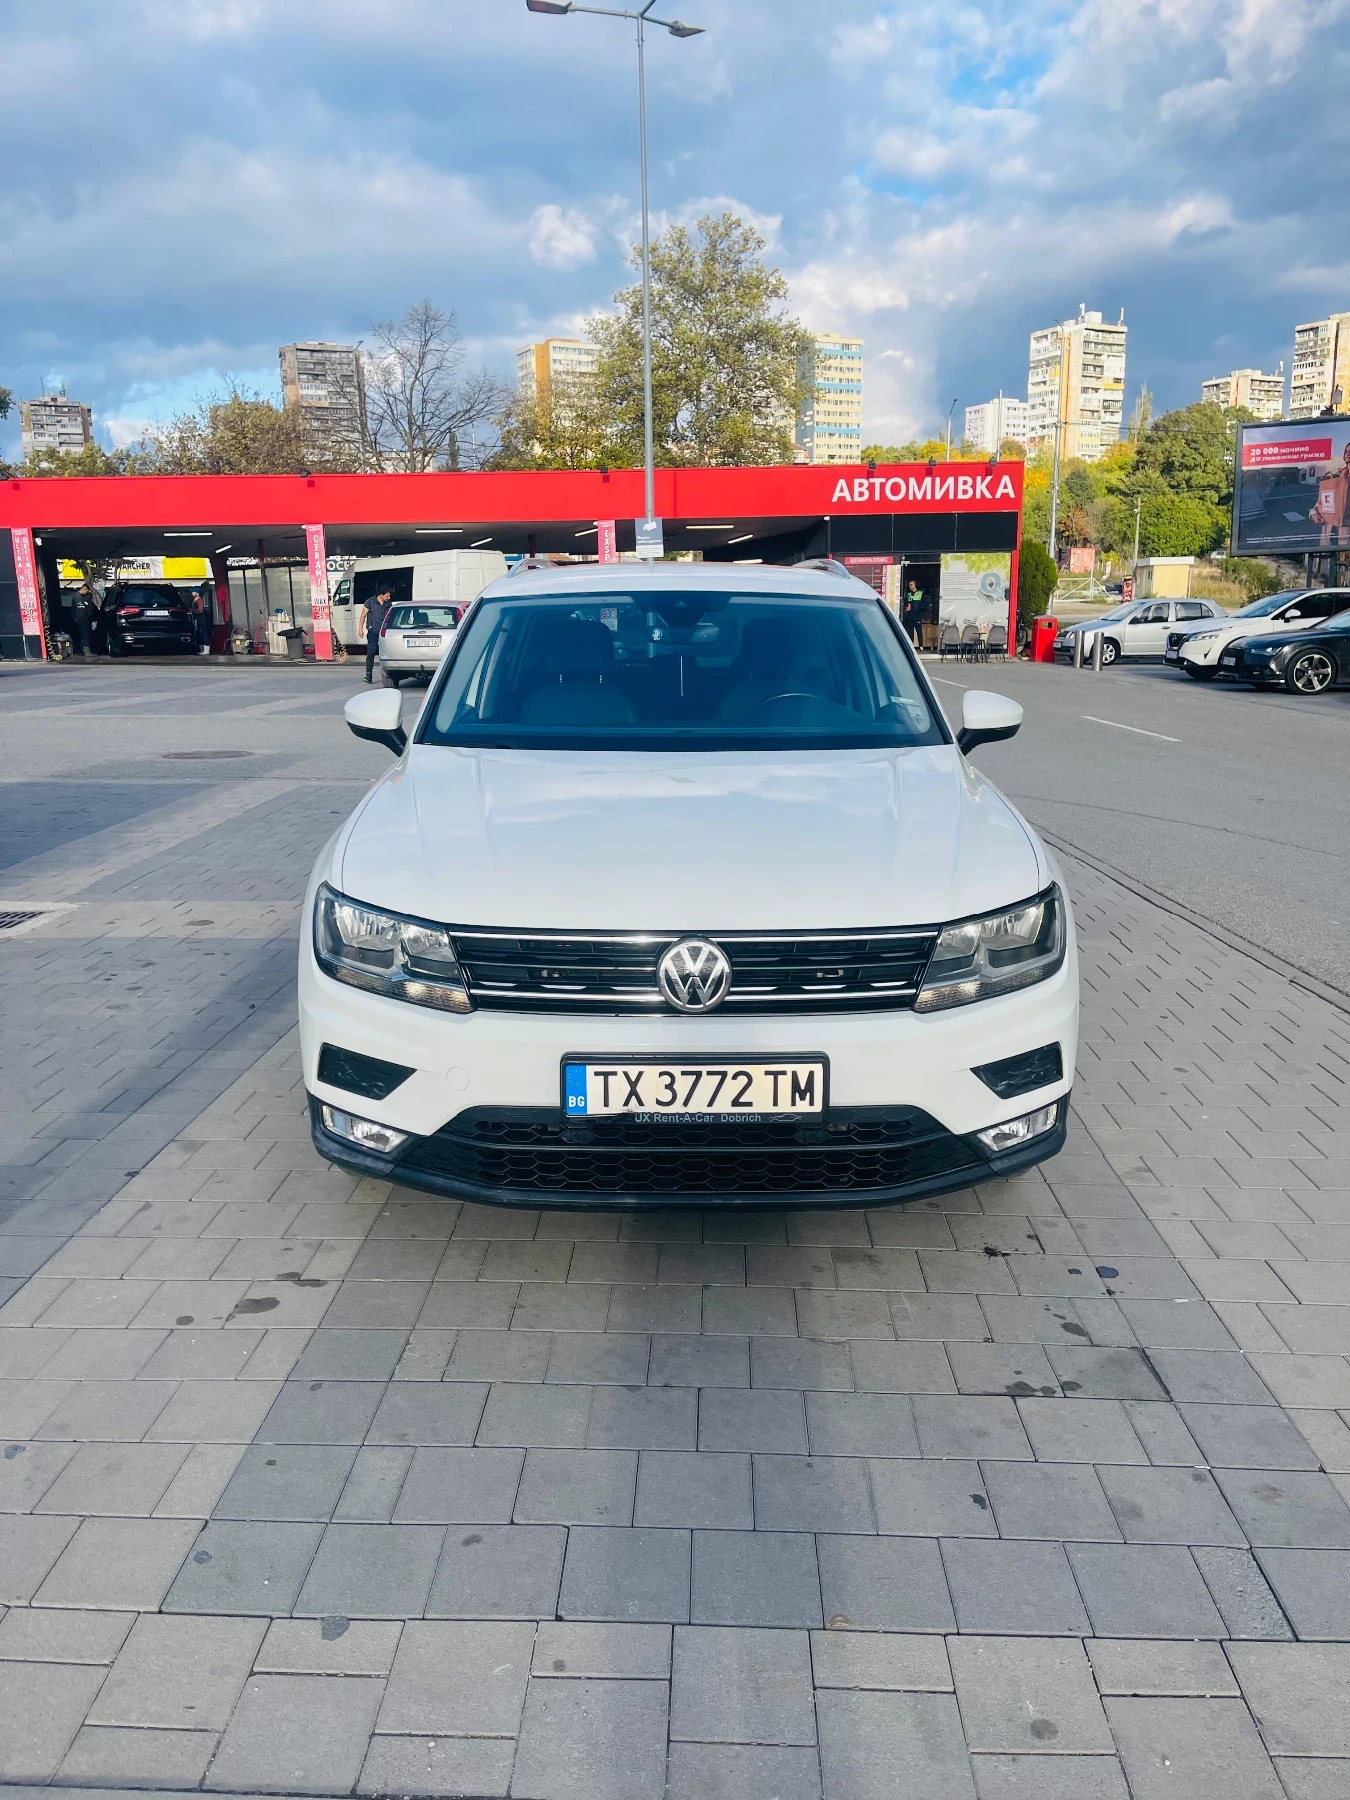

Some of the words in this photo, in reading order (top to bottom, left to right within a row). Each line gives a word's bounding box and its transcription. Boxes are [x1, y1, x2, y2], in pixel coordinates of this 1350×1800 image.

[1250, 448, 1261, 456] 20
[1263, 447, 1279, 455] 000
[1280, 446, 1310, 454] начина
[1300, 452, 1325, 460] грижа
[831, 475, 1016, 502] АВТОМИВКА
[313, 535, 322, 594] CERAMIC
[594, 1071, 645, 1107] TX
[655, 1070, 753, 1108] 3772
[764, 1070, 815, 1107] TM
[568, 1096, 585, 1108] BG
[653, 1112, 715, 1124] Rent-A-Car
[720, 1112, 762, 1123] Dobrich
